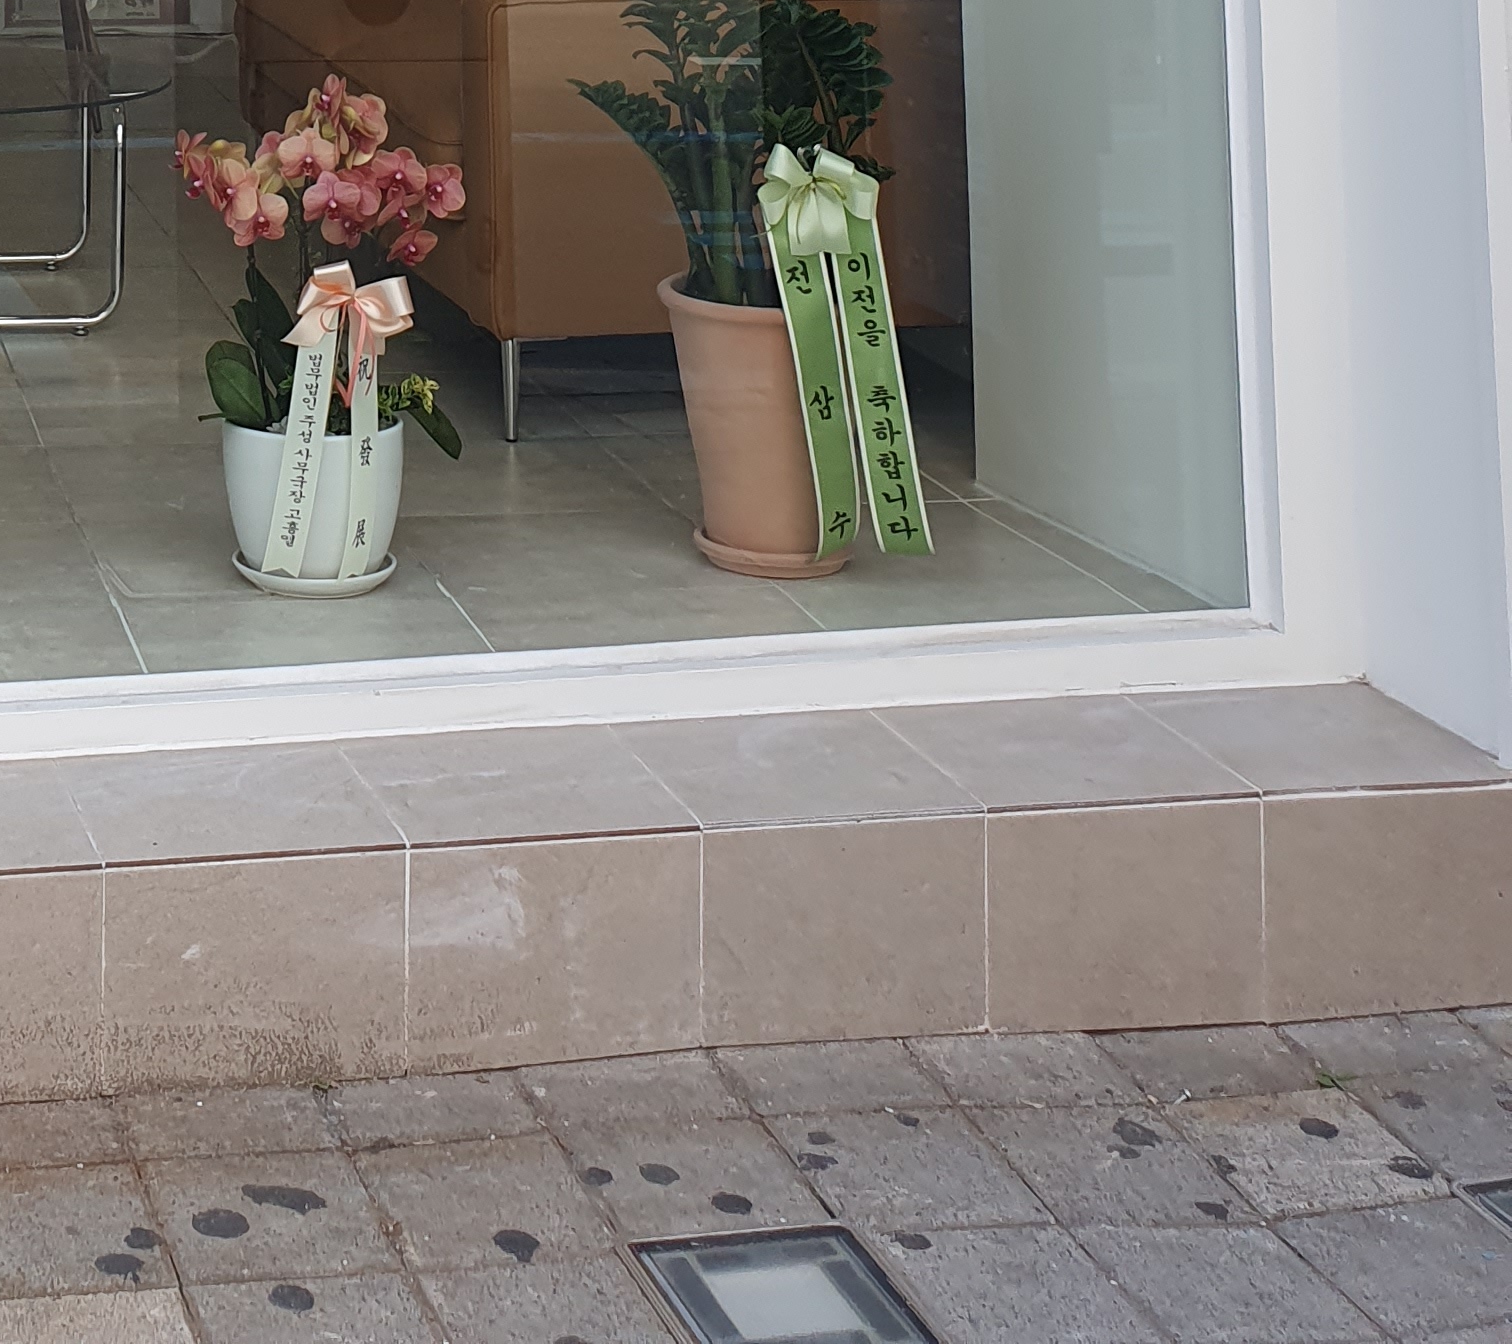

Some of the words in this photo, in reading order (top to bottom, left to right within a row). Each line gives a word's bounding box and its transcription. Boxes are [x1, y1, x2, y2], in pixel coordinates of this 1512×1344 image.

[846, 252, 888, 348] 이전을
[301, 353, 324, 410] 법무법인
[298, 415, 317, 444] 주성
[288, 448, 313, 503] 사무국장
[866, 384, 920, 541] 축하합니다
